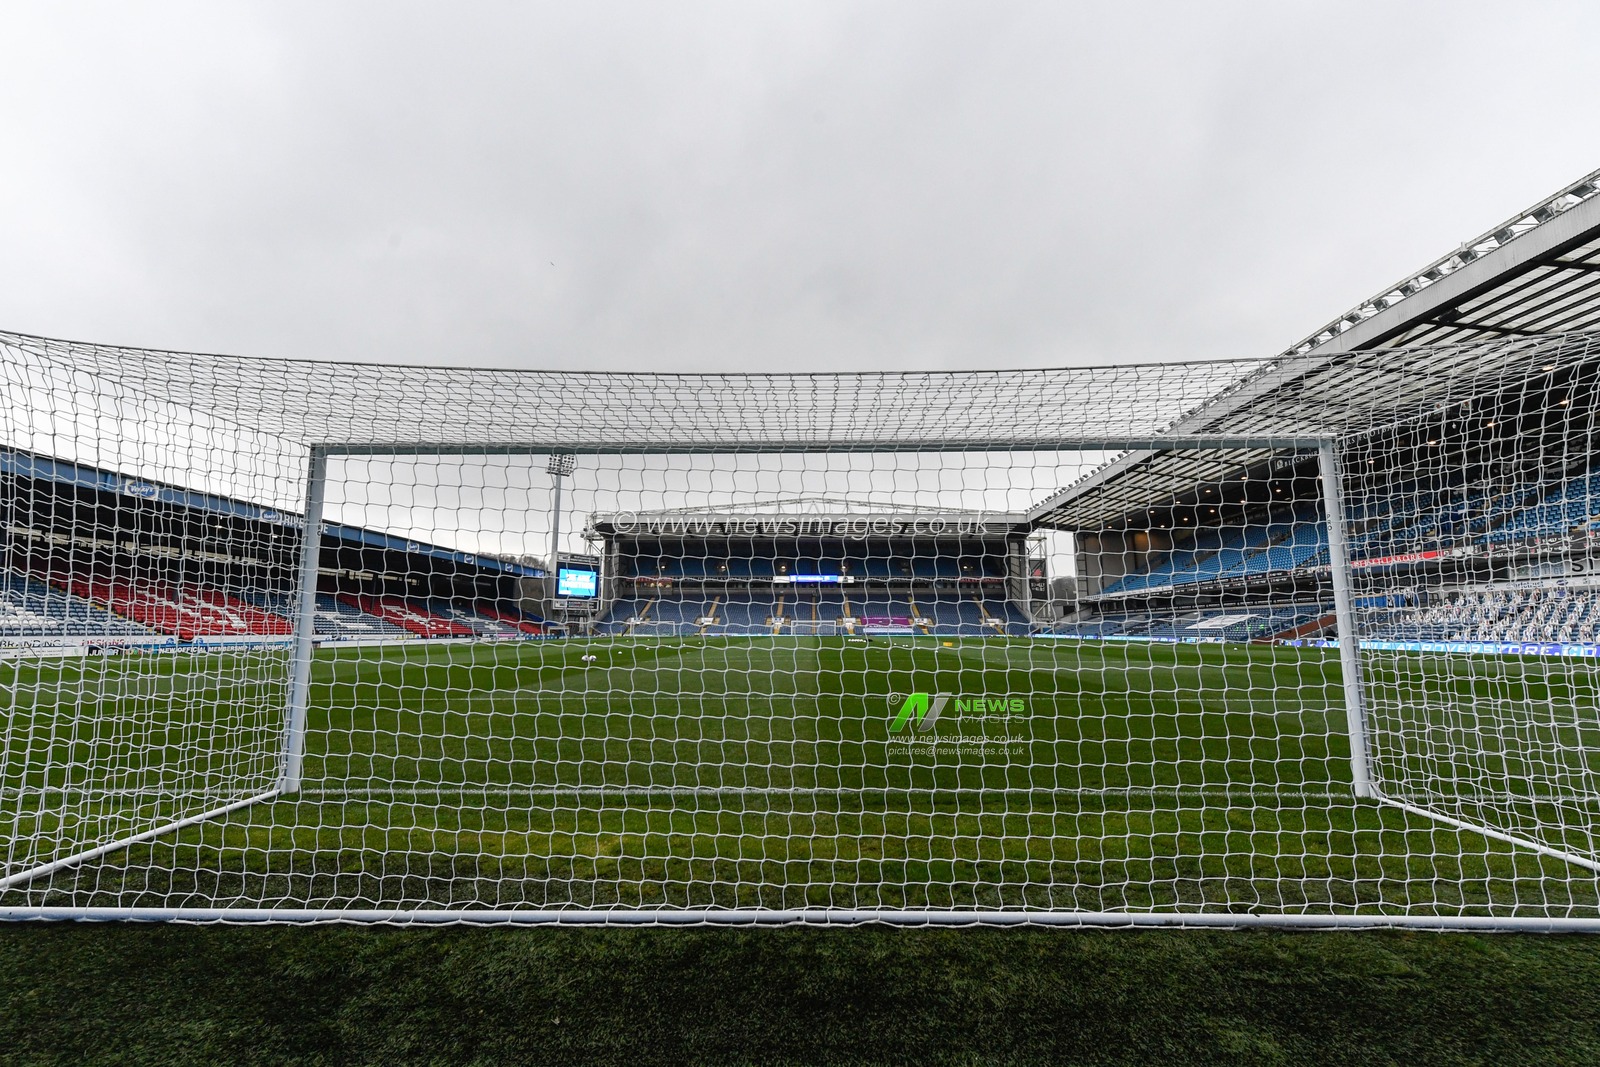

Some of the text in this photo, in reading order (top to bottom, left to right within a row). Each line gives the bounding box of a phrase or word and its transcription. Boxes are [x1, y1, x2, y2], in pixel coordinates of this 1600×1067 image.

[0, 640, 61, 648] BRANDNG
[89, 648, 120, 657] JUNOR
[177, 645, 206, 653] OFFICAL
